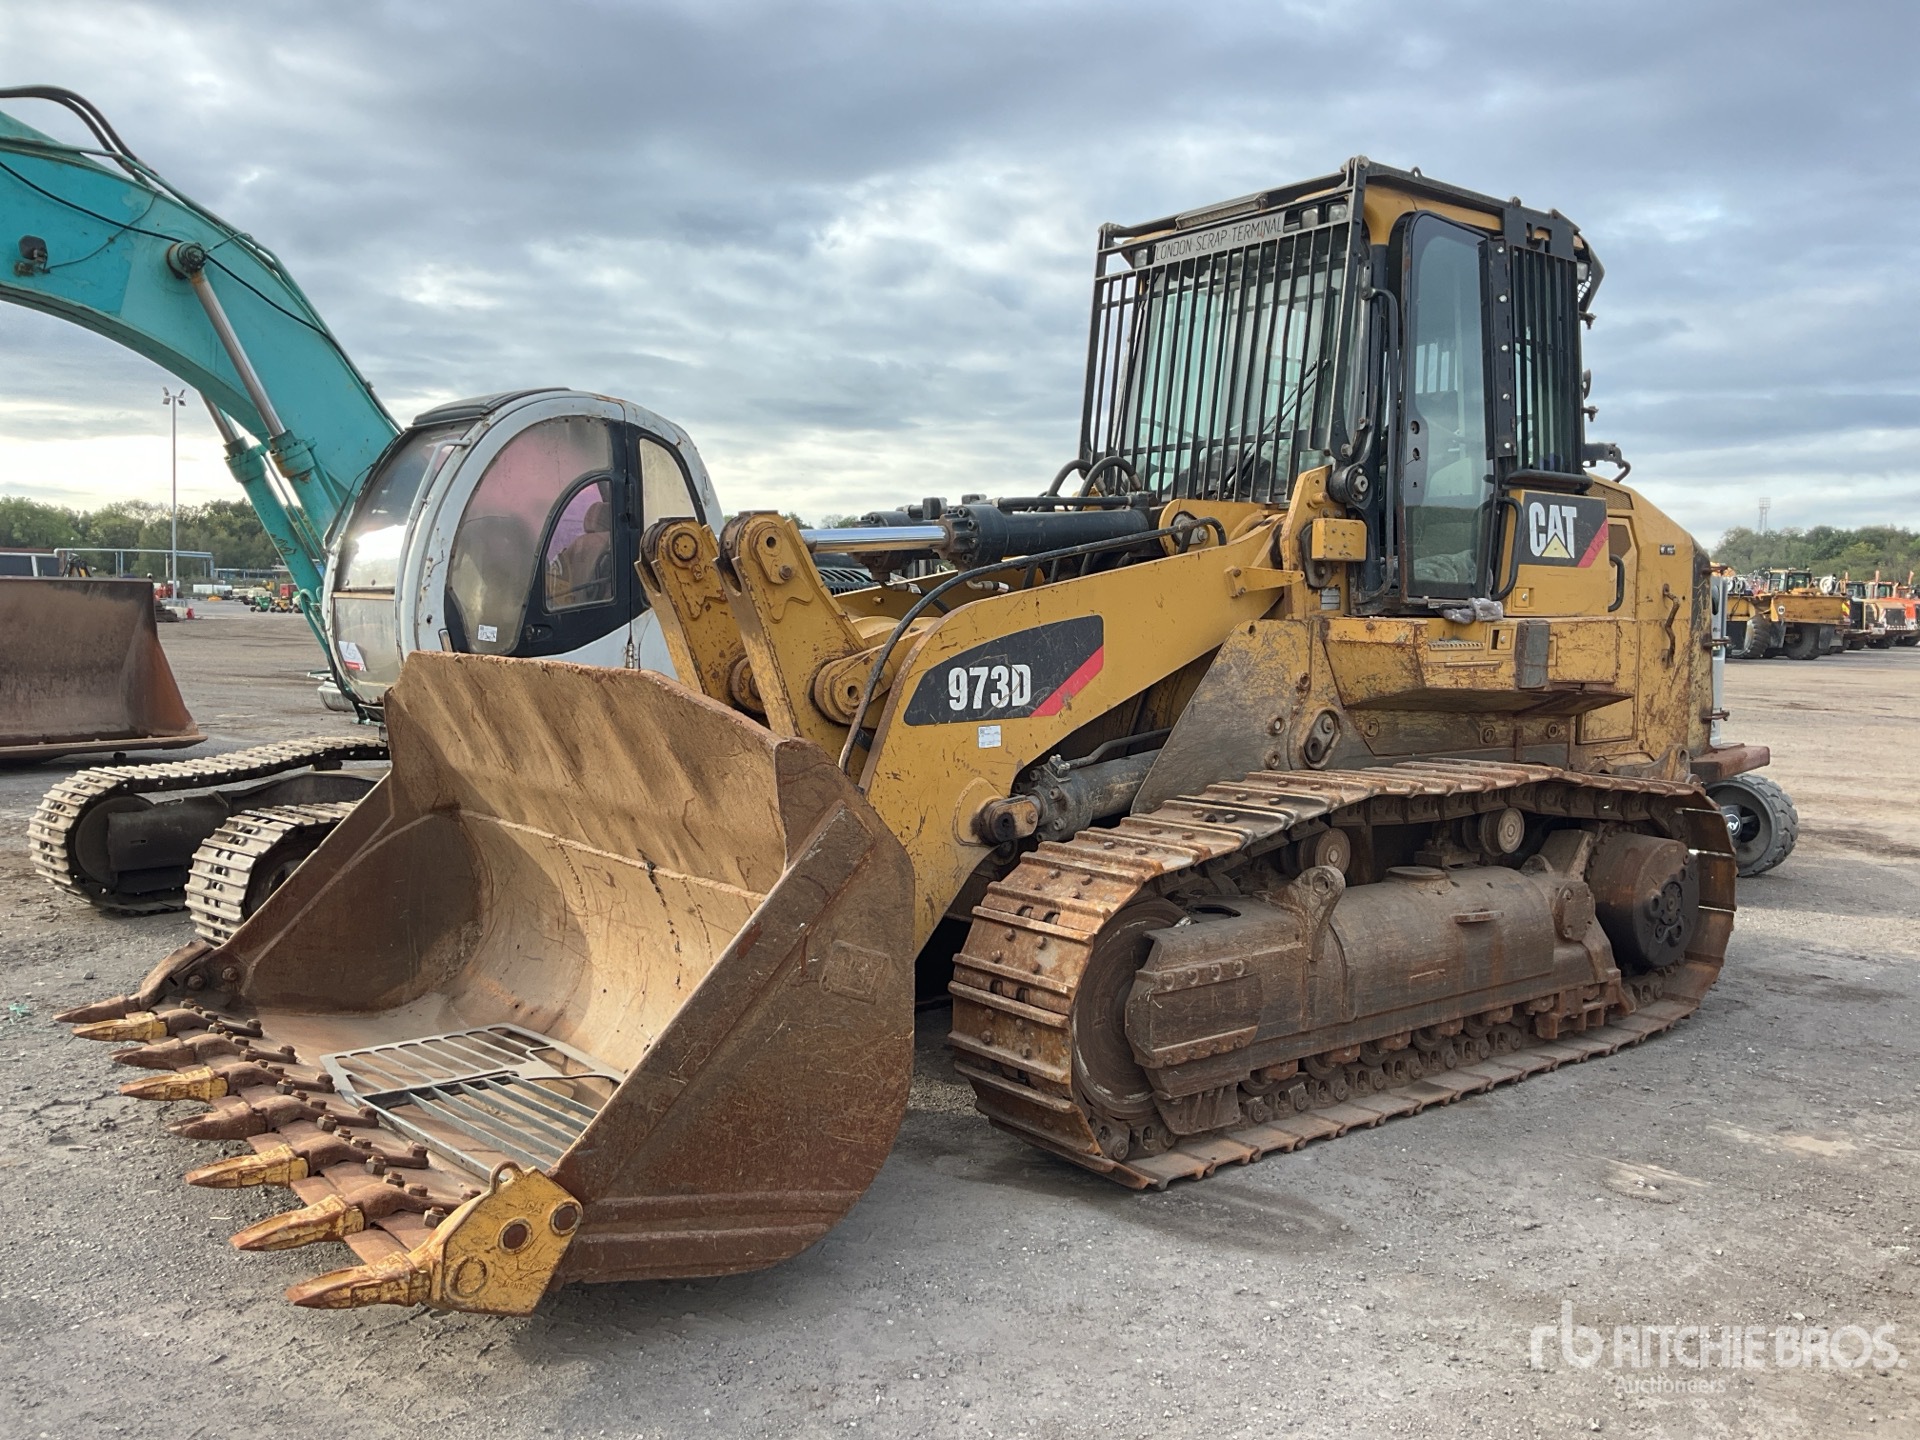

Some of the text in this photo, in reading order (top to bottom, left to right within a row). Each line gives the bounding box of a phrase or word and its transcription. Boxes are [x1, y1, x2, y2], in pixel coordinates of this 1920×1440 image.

[1155, 216, 1281, 260] LONDON SCRAP TERMINAL
[1529, 502, 1577, 558] CAT
[948, 664, 1031, 711] 973D
